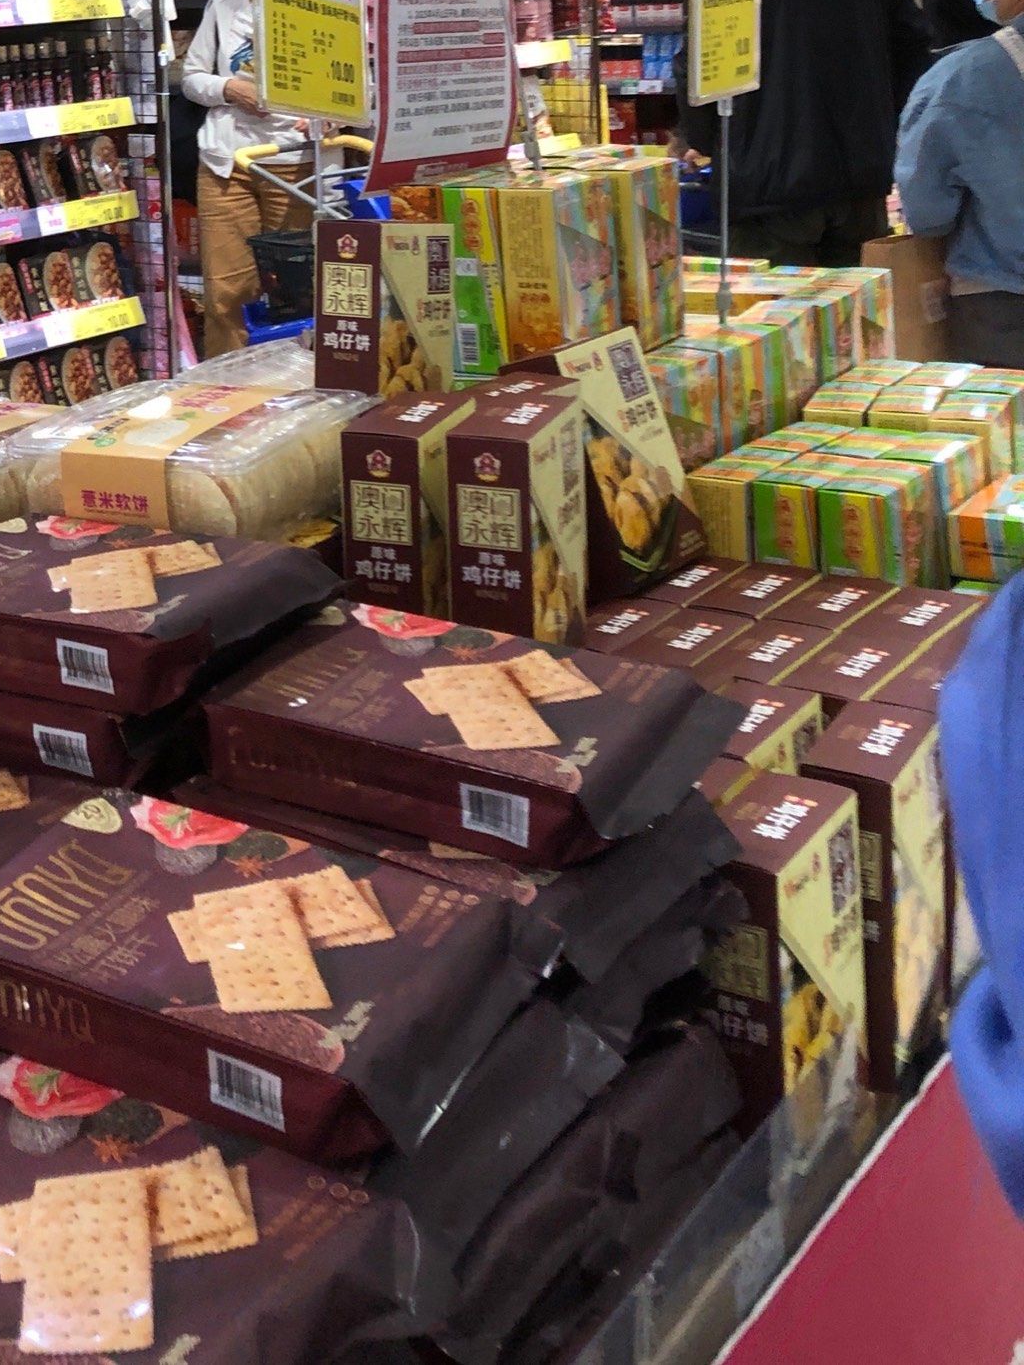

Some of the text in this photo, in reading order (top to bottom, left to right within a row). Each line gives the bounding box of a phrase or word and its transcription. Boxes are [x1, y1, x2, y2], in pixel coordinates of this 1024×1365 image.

[325, 265, 370, 289] 澳门
[325, 290, 371, 316] 永辉
[323, 332, 372, 353] 鸡仔饼
[356, 486, 406, 512] 澳门
[355, 560, 413, 584] 鸡仔饼
[461, 566, 523, 590] 鸡仔饼
